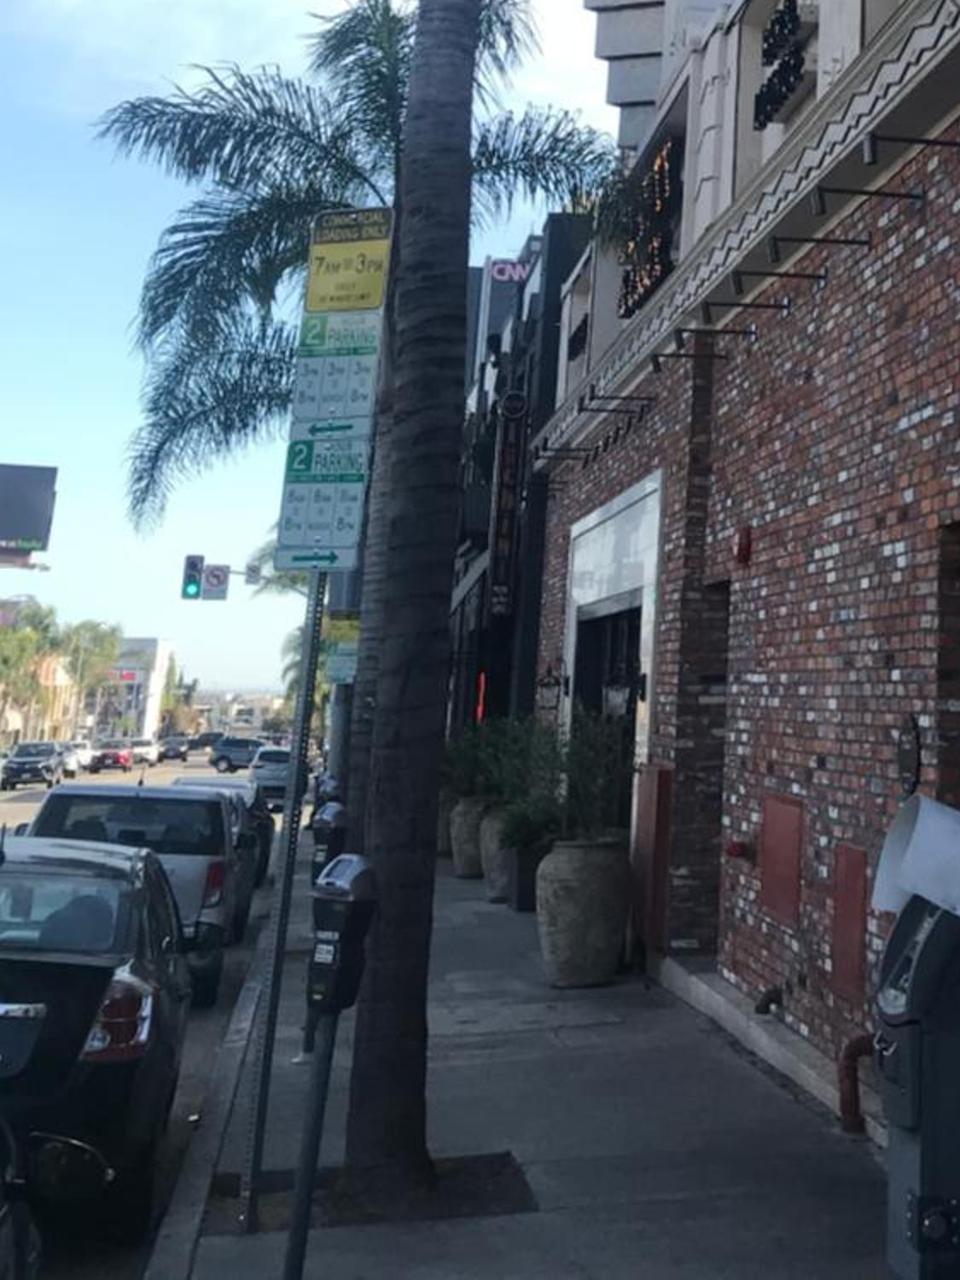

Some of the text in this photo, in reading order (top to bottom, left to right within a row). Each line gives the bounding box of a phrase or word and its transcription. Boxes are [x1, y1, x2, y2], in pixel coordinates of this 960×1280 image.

[305, 321, 320, 345] 2
[293, 443, 308, 470] 2
[314, 452, 363, 472] PARKING
